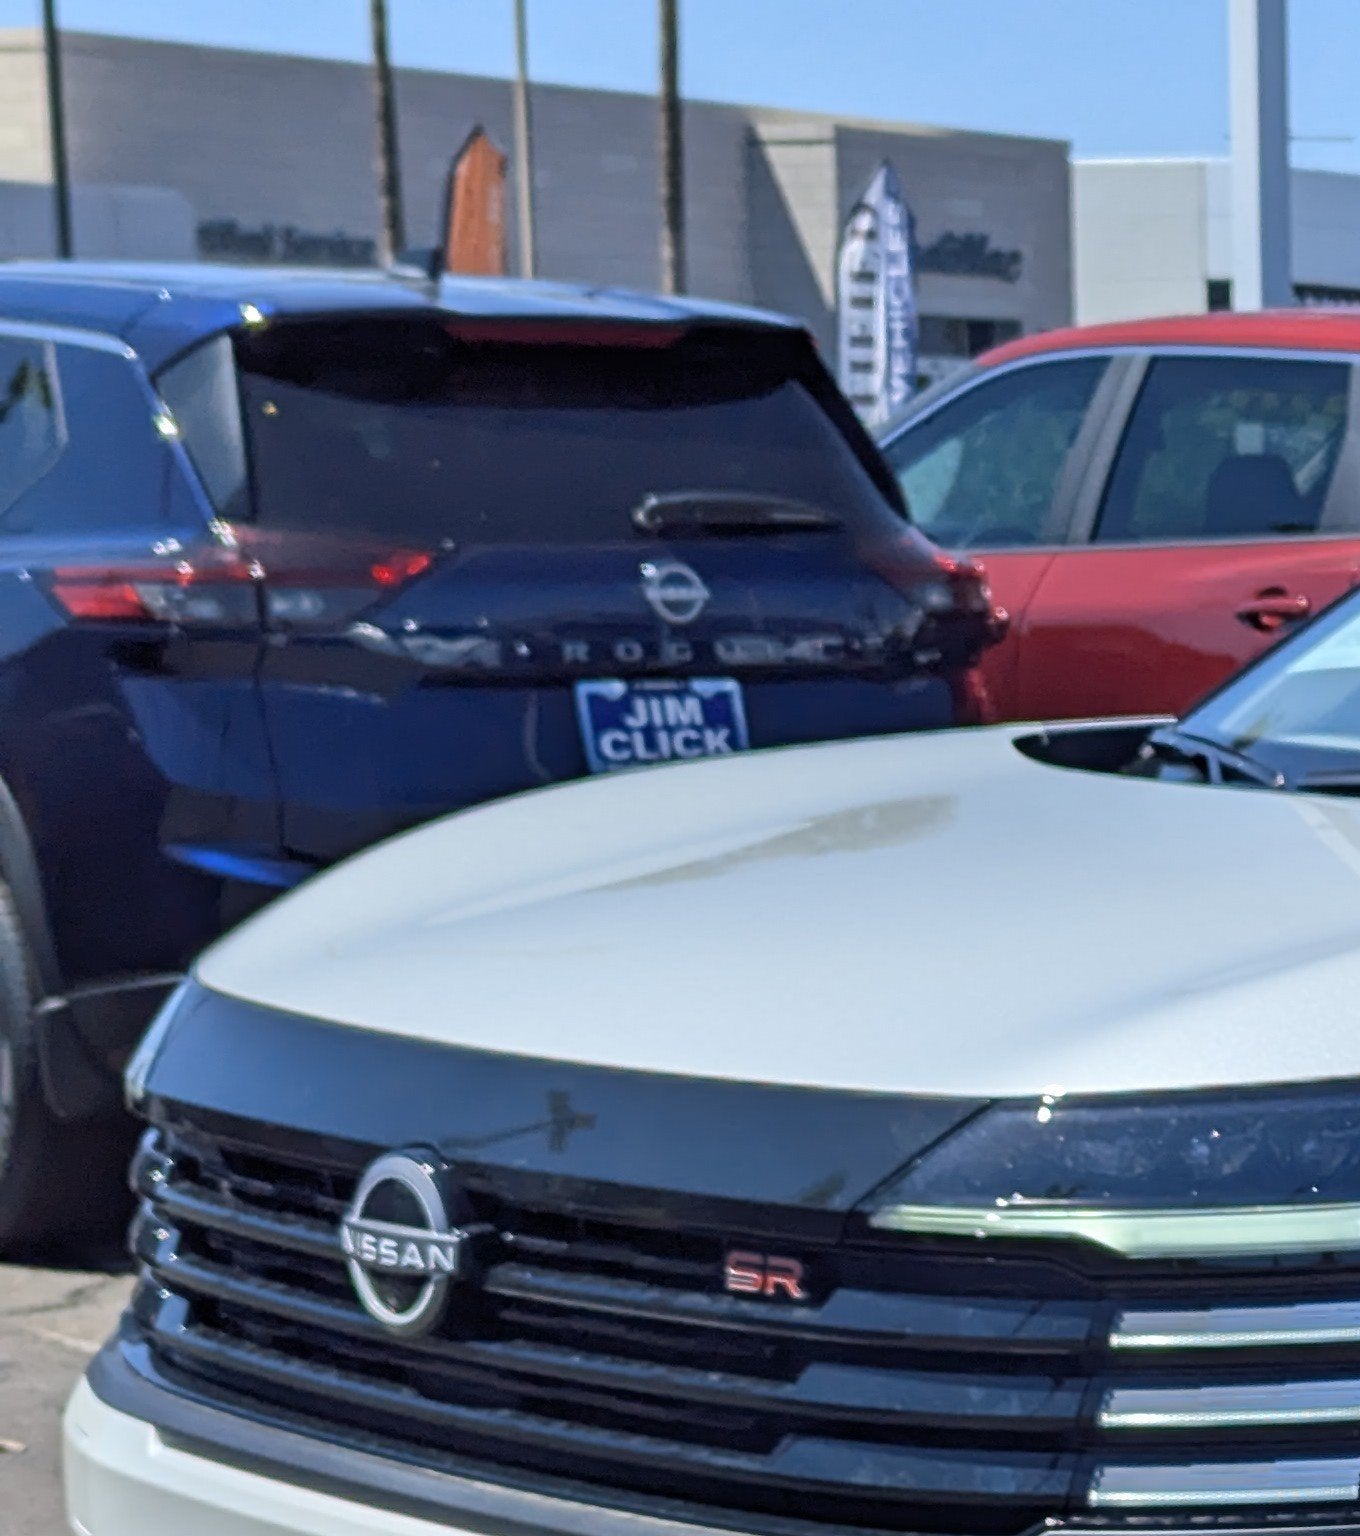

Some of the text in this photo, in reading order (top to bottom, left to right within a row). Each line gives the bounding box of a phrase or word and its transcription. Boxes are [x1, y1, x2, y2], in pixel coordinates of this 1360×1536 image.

[624, 696, 704, 728] JIM
[600, 728, 734, 760] CLICK
[341, 1223, 455, 1272] NISSAN
[726, 1252, 804, 1299] SR
